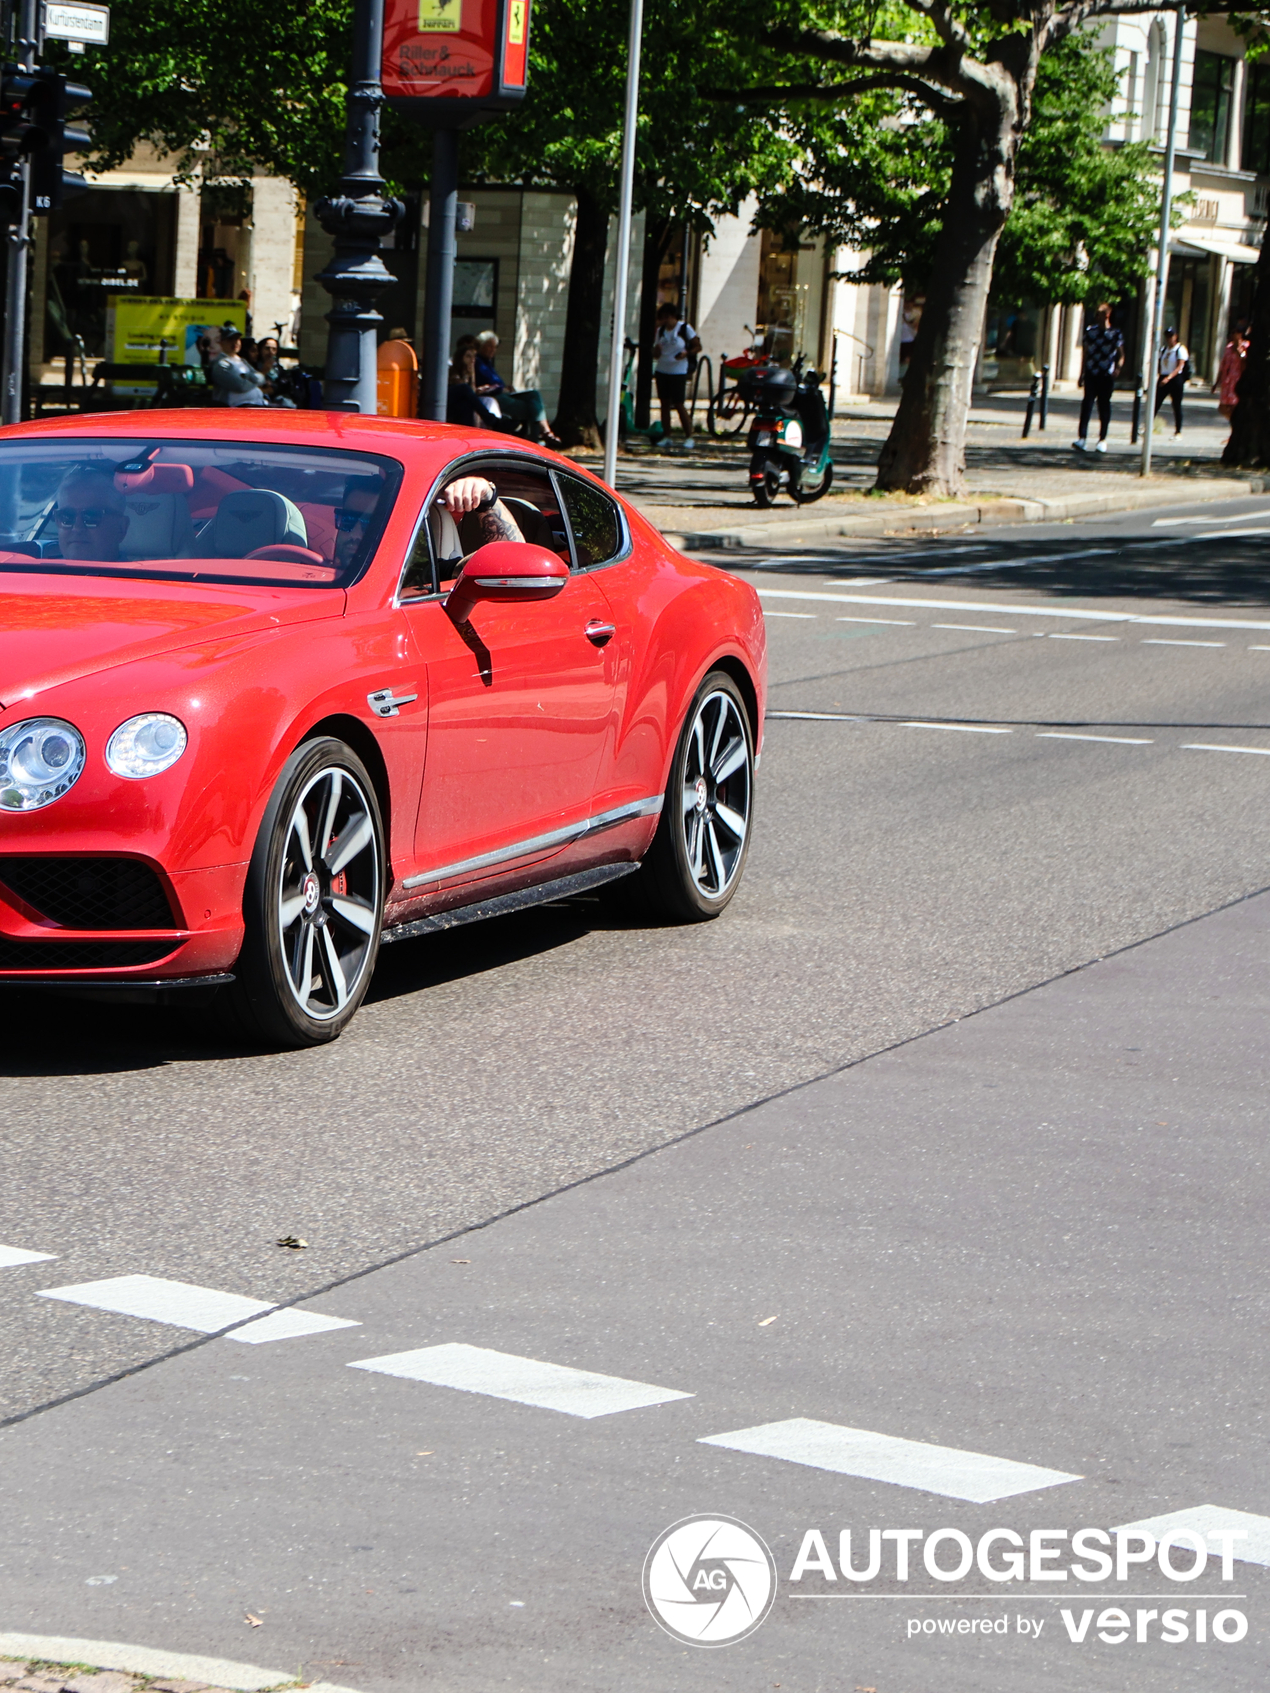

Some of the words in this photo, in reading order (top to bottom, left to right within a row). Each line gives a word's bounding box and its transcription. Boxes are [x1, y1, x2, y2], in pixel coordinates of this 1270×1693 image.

[47, 8, 104, 32] Kurfürstendamm
[399, 44, 438, 60] Riller
[399, 61, 476, 77] Schnauck
[35, 195, 51, 208] K6
